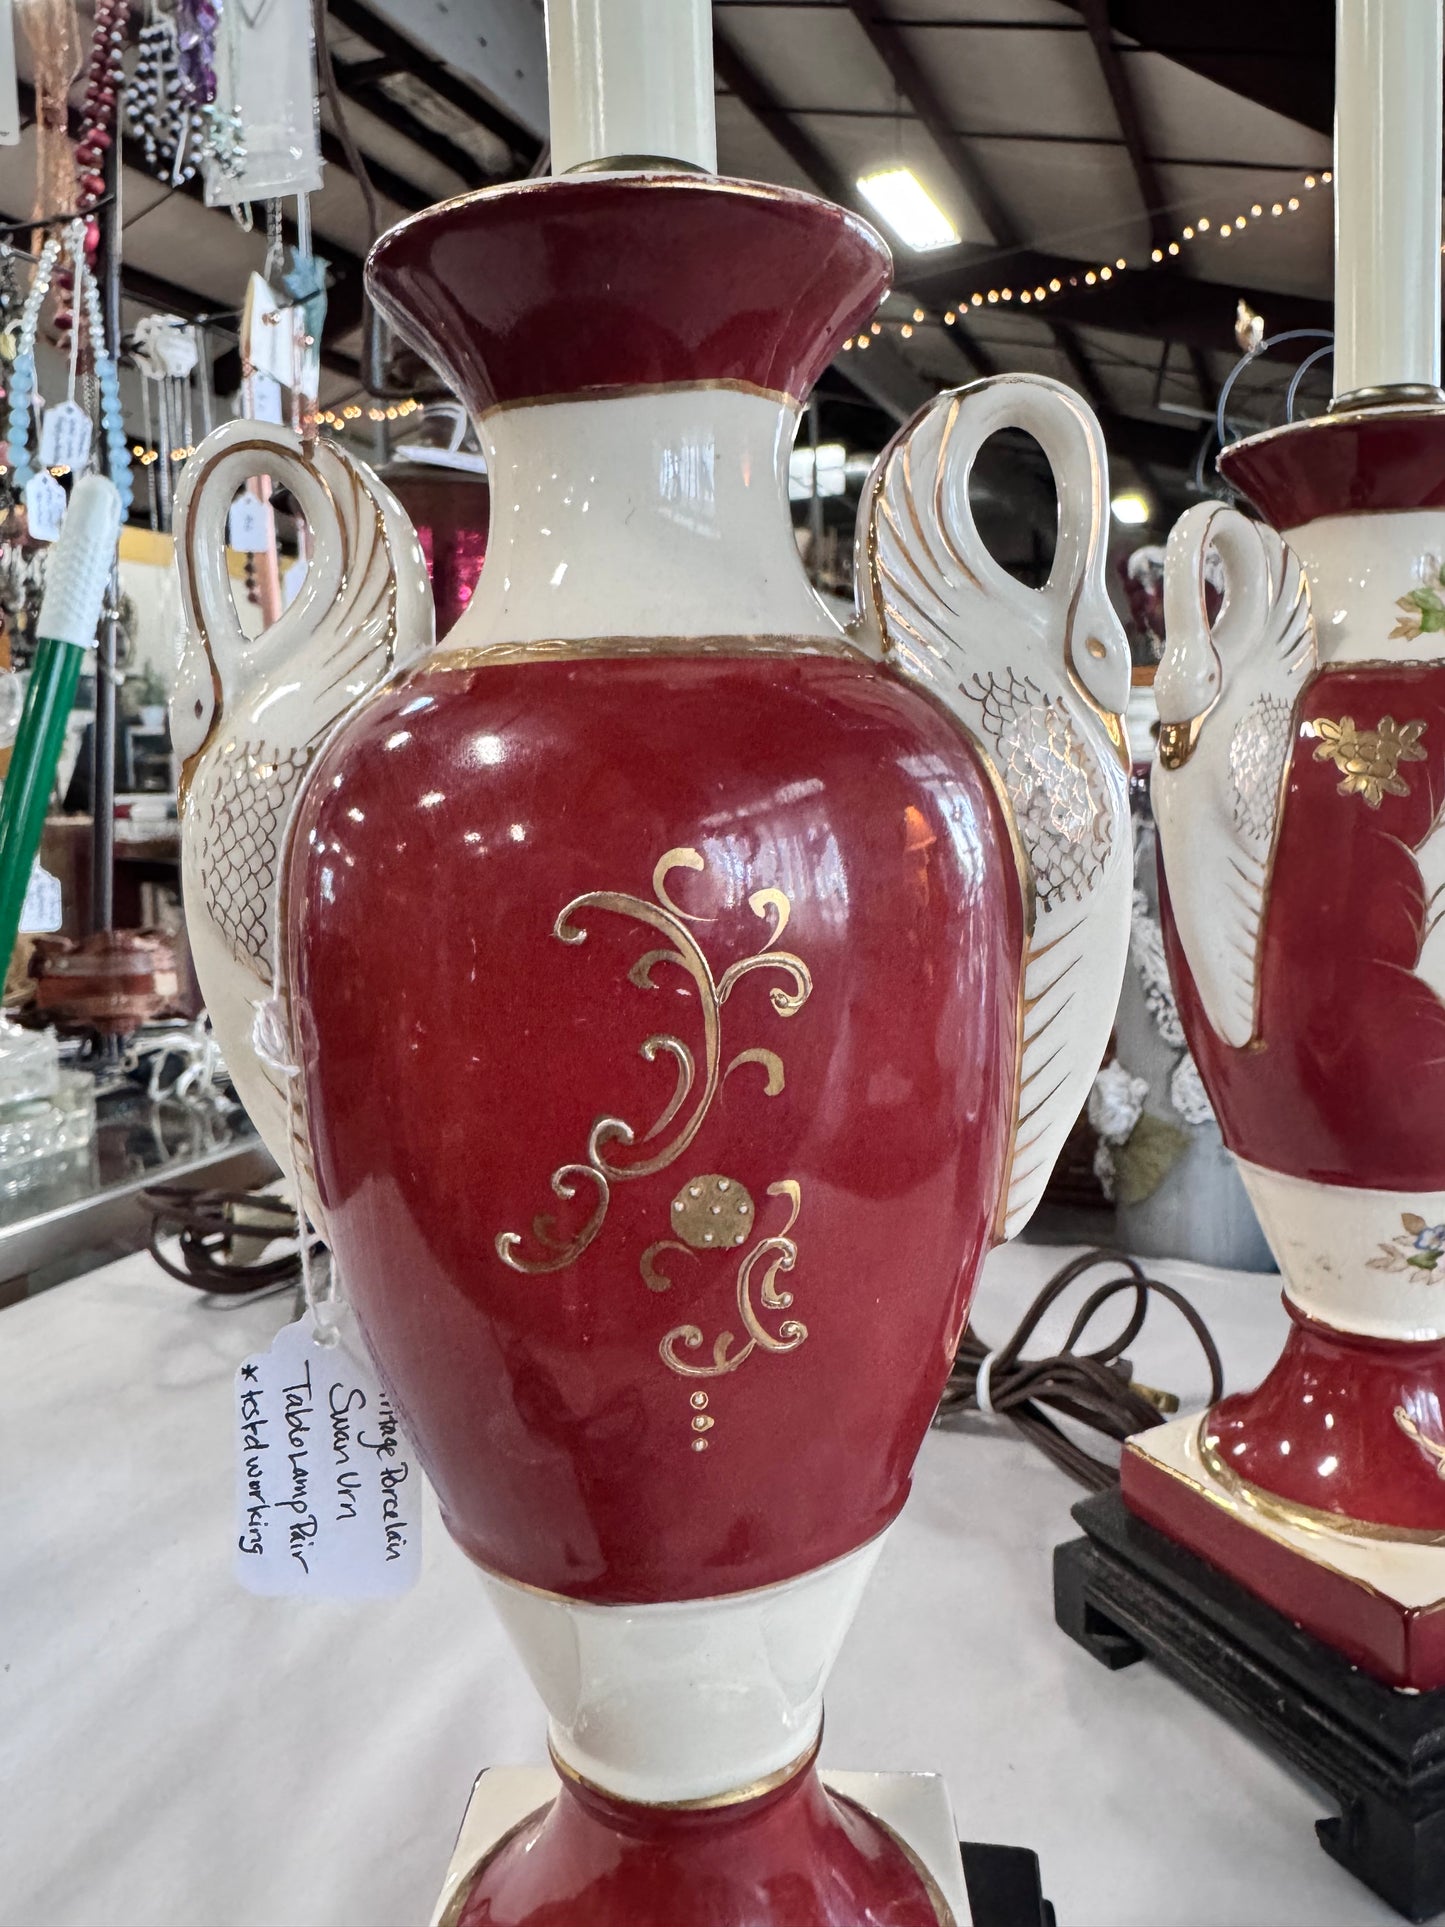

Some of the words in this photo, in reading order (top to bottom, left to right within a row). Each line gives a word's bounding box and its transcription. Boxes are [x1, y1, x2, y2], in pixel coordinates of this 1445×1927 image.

[282, 1359, 314, 1448] Table
[329, 1382, 366, 1466] Swan
[238, 1455, 271, 1555] working
[274, 1450, 308, 1514] Lamp
[336, 1471, 362, 1521] Urn
[380, 1461, 409, 1562] Porcelain
[289, 1513, 318, 1575] Pair
